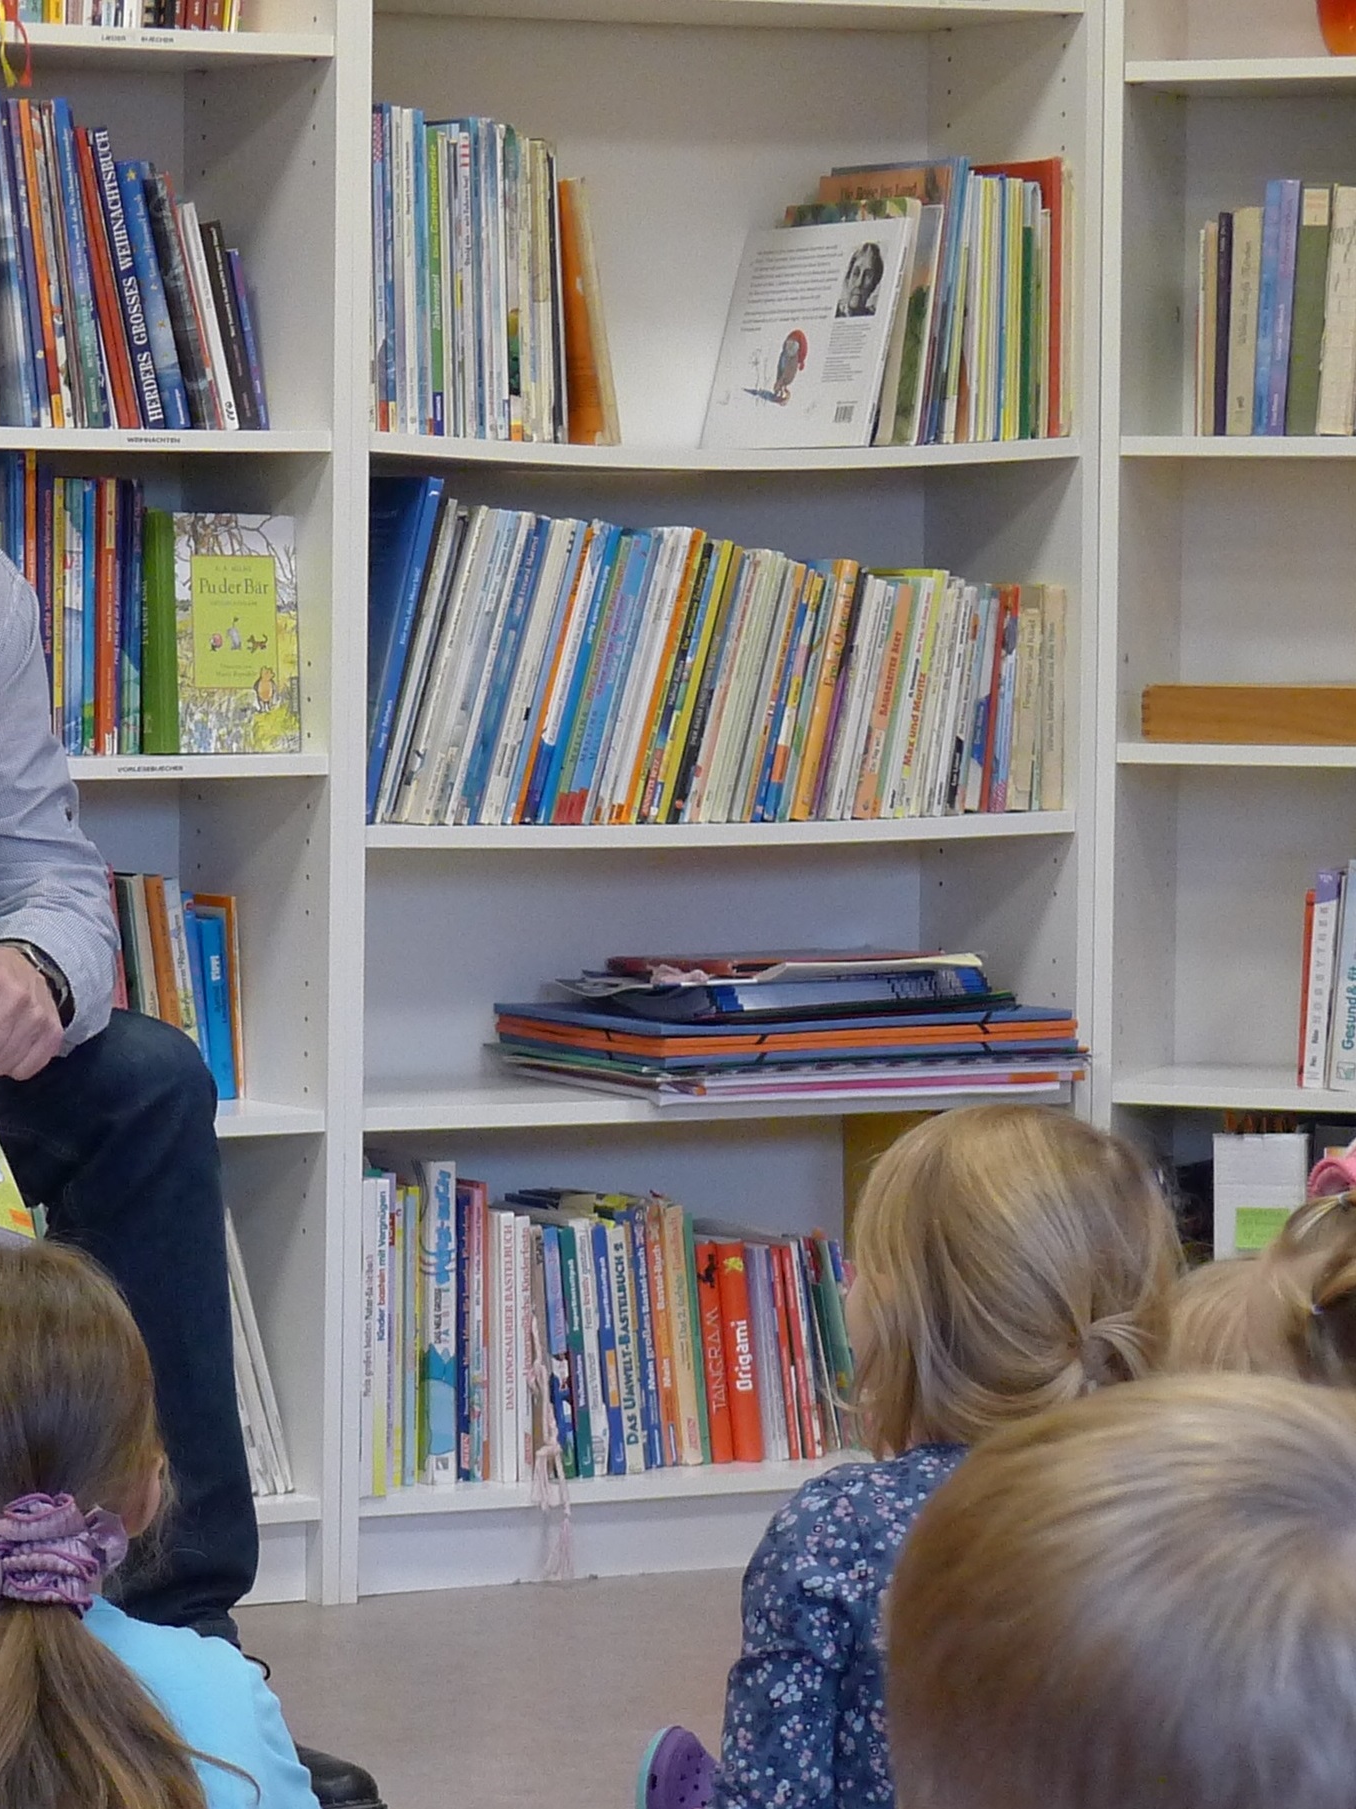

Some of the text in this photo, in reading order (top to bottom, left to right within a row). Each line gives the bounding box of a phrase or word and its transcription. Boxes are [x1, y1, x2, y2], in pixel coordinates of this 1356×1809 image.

[427, 144, 439, 233] Gartenparadiese
[93, 129, 164, 421] HERDERS GROSSES WEIHNACHTSBUCH
[430, 273, 441, 330] Zinkernagel
[199, 577, 270, 596] Pu der Bär
[43, 611, 53, 637] große
[909, 670, 927, 712] Moritz
[901, 739, 916, 767] Max
[905, 712, 920, 739] und
[1341, 995, 1356, 1051] Gesund
[375, 1190, 388, 1342] Kinder basteln mit Vergnügen
[520, 1227, 531, 1292] Kinderfeste
[576, 1234, 591, 1274] gestalten
[651, 1244, 665, 1310] Bastel-Buch
[433, 1287, 442, 1312] GROSSE
[503, 1224, 514, 1410] DAS DINOSAURIER BASTELBUCH
[636, 1246, 655, 1390] Mein großes Bastel-Buch
[433, 1330, 441, 1344] DAS
[612, 1242, 640, 1445] DAS UMWELT-BASTELBUCH 2
[704, 1305, 727, 1413] TANGRAM
[730, 1318, 754, 1392] Origami
[660, 1358, 672, 1387] Mein
